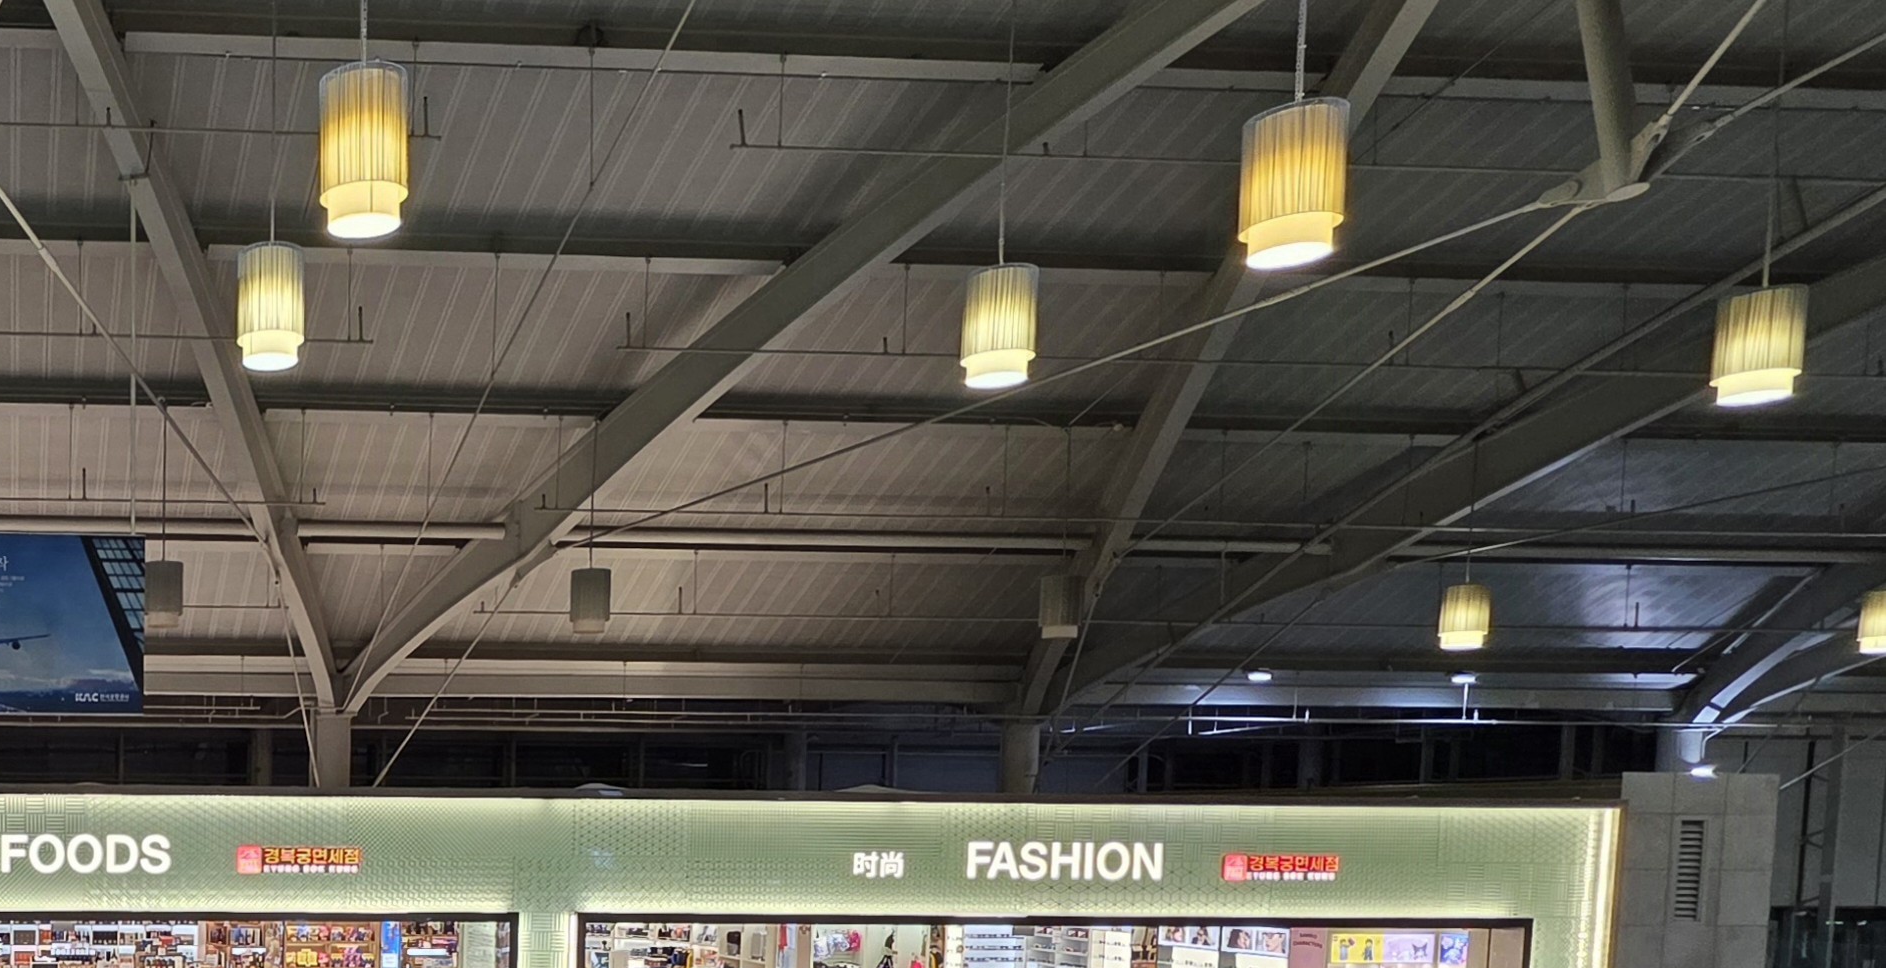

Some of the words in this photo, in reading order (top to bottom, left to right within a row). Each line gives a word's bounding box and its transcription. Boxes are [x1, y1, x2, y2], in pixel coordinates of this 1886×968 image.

[0, 833, 172, 874] FOODS
[264, 848, 360, 865] 경복궁면세점
[853, 851, 904, 879] 时尚
[966, 841, 1164, 881] FASHION
[1249, 855, 1340, 872] 경복궁면세점
